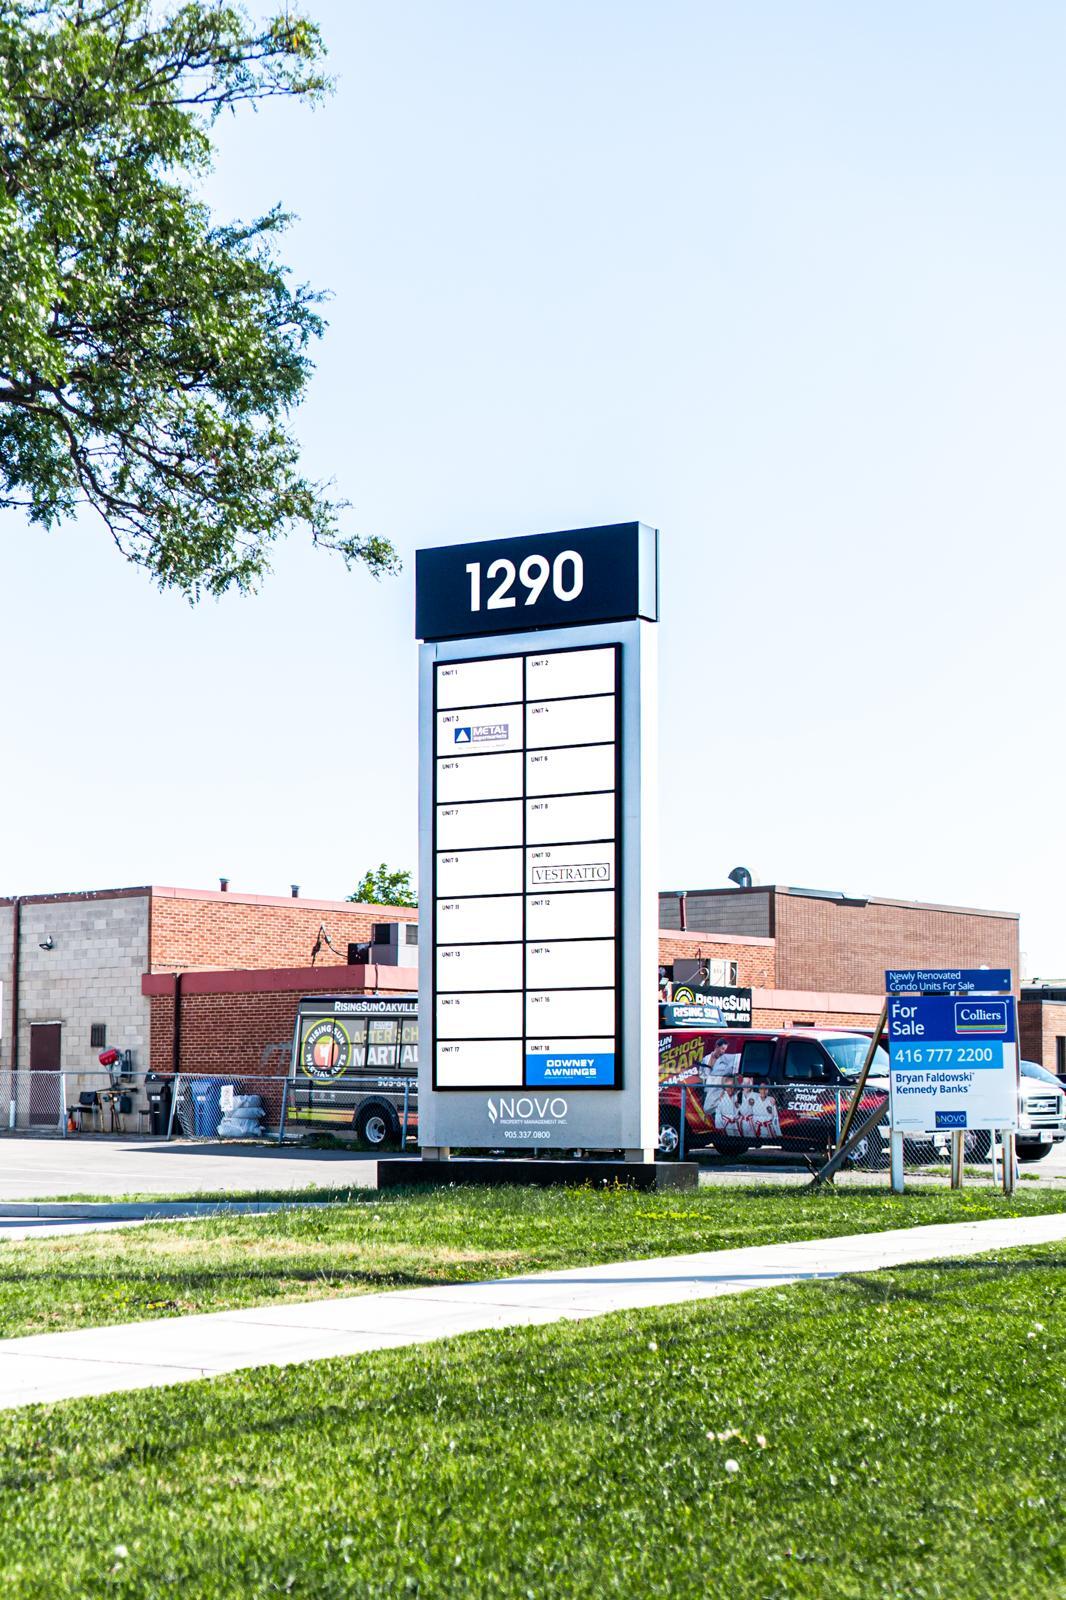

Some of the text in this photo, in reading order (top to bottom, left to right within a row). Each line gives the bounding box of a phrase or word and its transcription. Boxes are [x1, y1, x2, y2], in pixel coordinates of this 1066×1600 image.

[465, 550, 584, 612] 1290
[473, 725, 507, 736] METAL
[536, 866, 607, 880] VESTRATTO
[889, 971, 961, 983] Newly Renovated
[889, 981, 975, 991] Condo Units For Sale
[674, 1007, 704, 1018] RISING
[892, 1004, 918, 1018] For
[960, 1009, 1002, 1021] Colliers
[892, 1020, 925, 1036] Sale
[308, 1025, 346, 1045] RISING SUN
[661, 1036, 705, 1062] SCHOOL
[895, 1048, 993, 1063] 416 777 2200
[306, 1053, 347, 1078] MARTIAL ARTS
[546, 1059, 595, 1067] DOWNEY
[544, 1068, 597, 1076] AWNINGS
[895, 1072, 972, 1085] Bryan Faldowski
[896, 1084, 968, 1096] Kennedy Banks
[795, 1093, 817, 1102] FROM
[500, 1098, 568, 1118] NOVO
[787, 1101, 824, 1113] SCHOOL
[940, 1114, 966, 1123] NOVO
[504, 1130, 551, 1139] 905.337.0800
